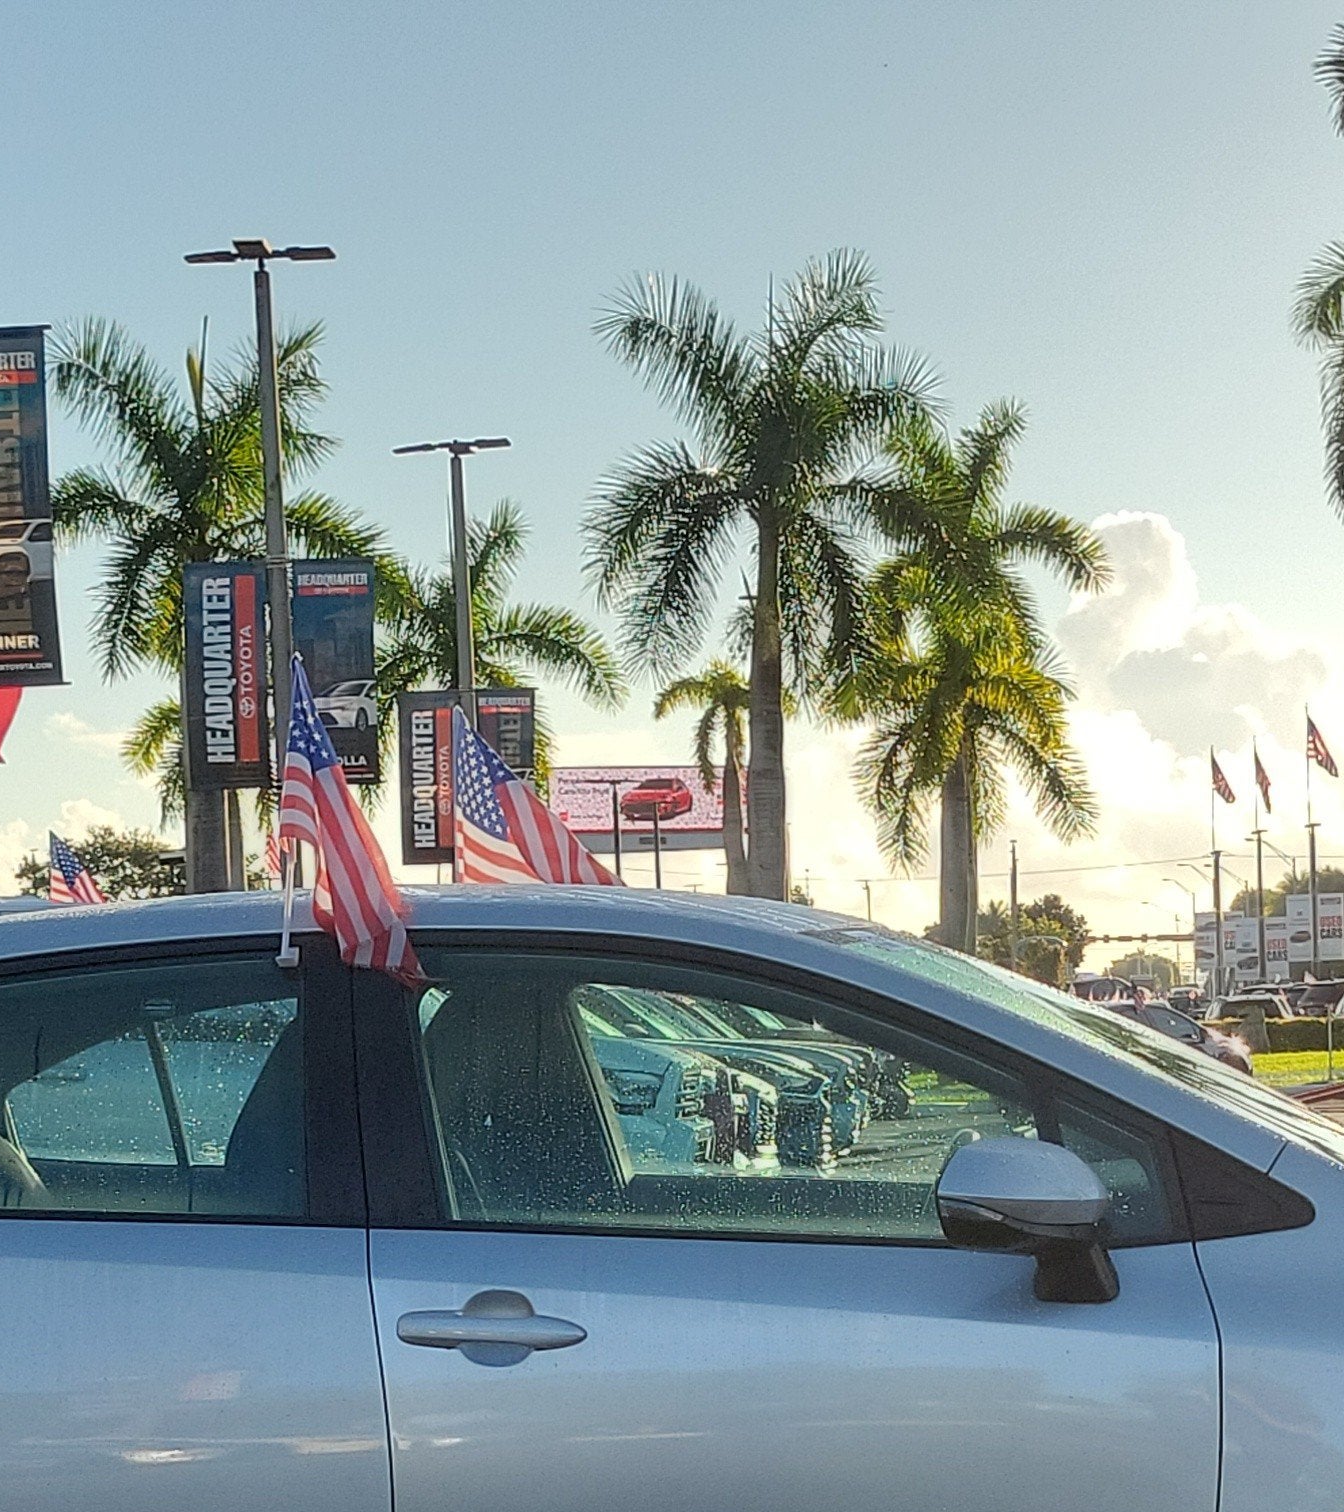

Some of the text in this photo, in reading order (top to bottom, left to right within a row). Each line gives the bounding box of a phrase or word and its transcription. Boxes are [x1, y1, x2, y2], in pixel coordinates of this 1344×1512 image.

[202, 577, 237, 764] HEADQUARTER
[239, 625, 253, 699] TOYOTA
[337, 754, 367, 767] OLLA
[411, 710, 438, 848] HEADQUARTER
[1319, 915, 1343, 927] USED
[1319, 927, 1343, 939] CARS
